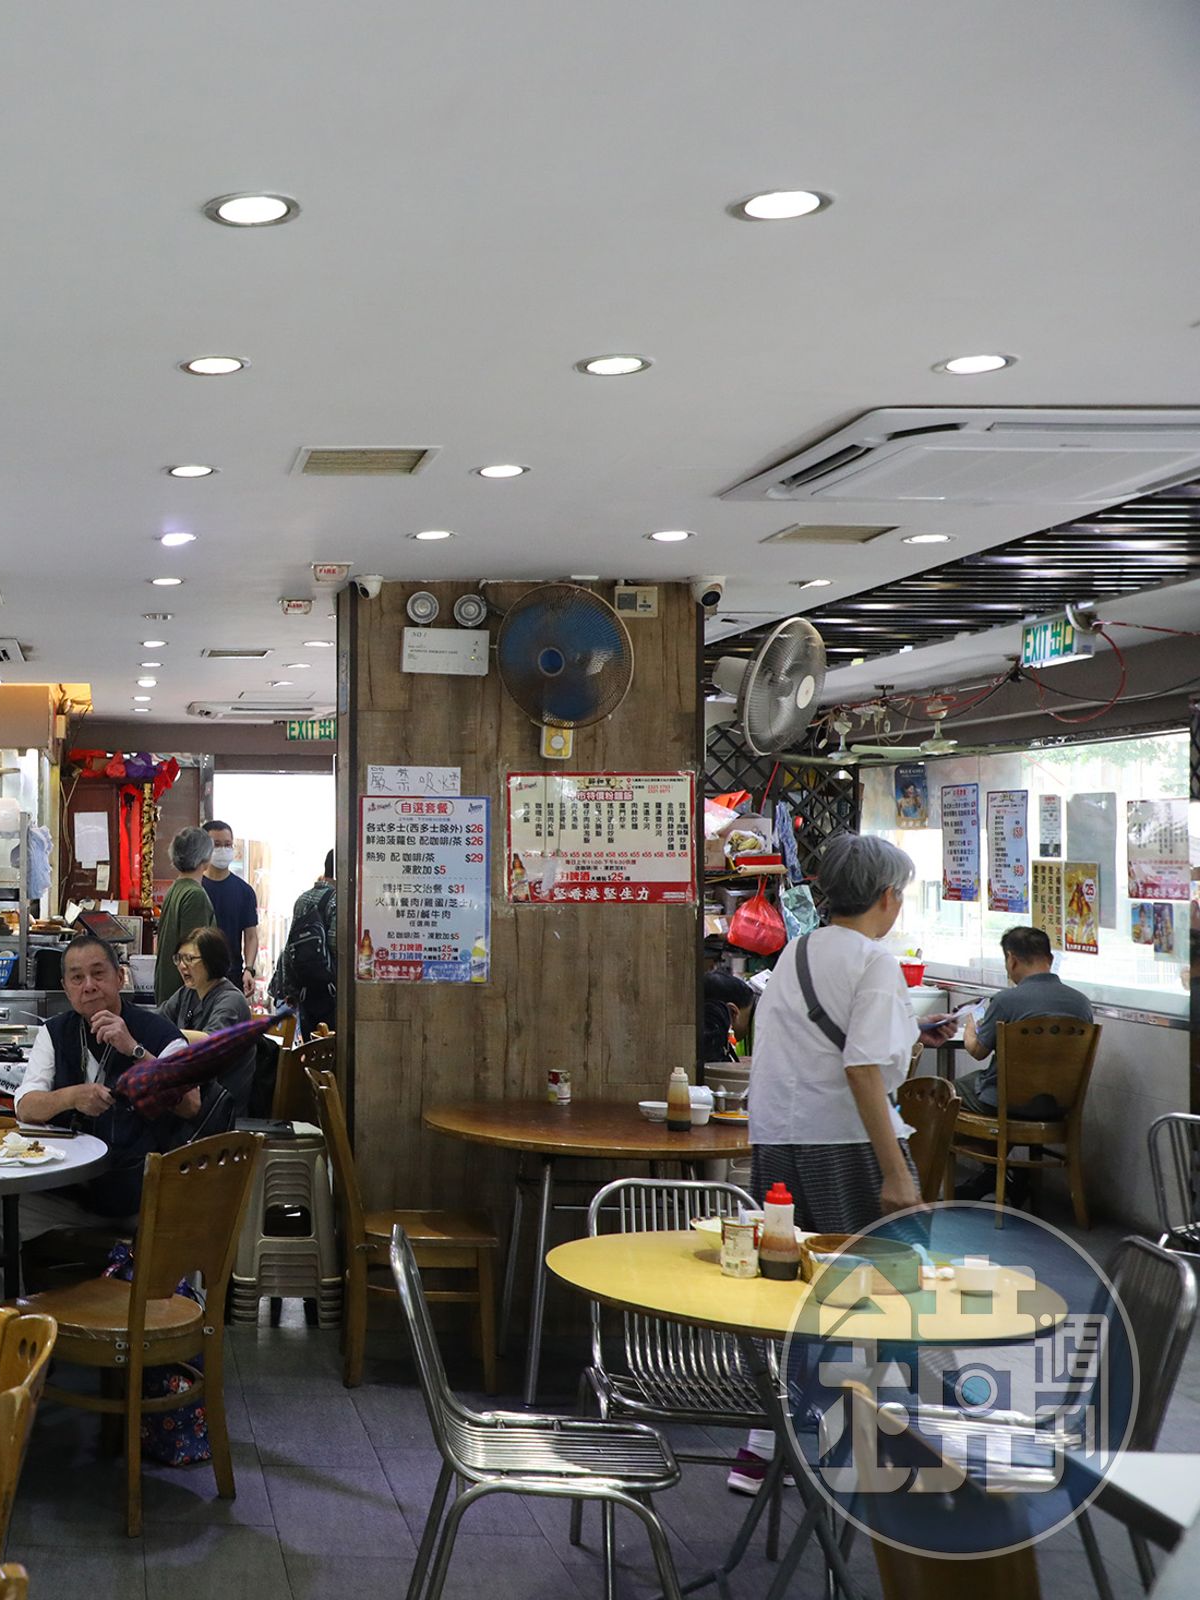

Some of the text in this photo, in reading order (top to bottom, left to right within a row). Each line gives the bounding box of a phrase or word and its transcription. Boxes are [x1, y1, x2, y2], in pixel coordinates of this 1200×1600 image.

[1023, 617, 1075, 663] EXIT 出口
[289, 719, 336, 740] EXIT 出
[370, 766, 460, 793] 嚴禁吸煙
[401, 802, 449, 814] 自選套餐
[366, 822, 484, 834] 各式多士(西多士除外) $26
[465, 835, 484, 846] $26
[366, 851, 385, 862] 熱狗
[464, 853, 484, 863] $29
[447, 884, 466, 894] $31
[395, 909, 452, 920] 鮮茄/鹹牛肉
[390, 943, 423, 952] 生力啤酒
